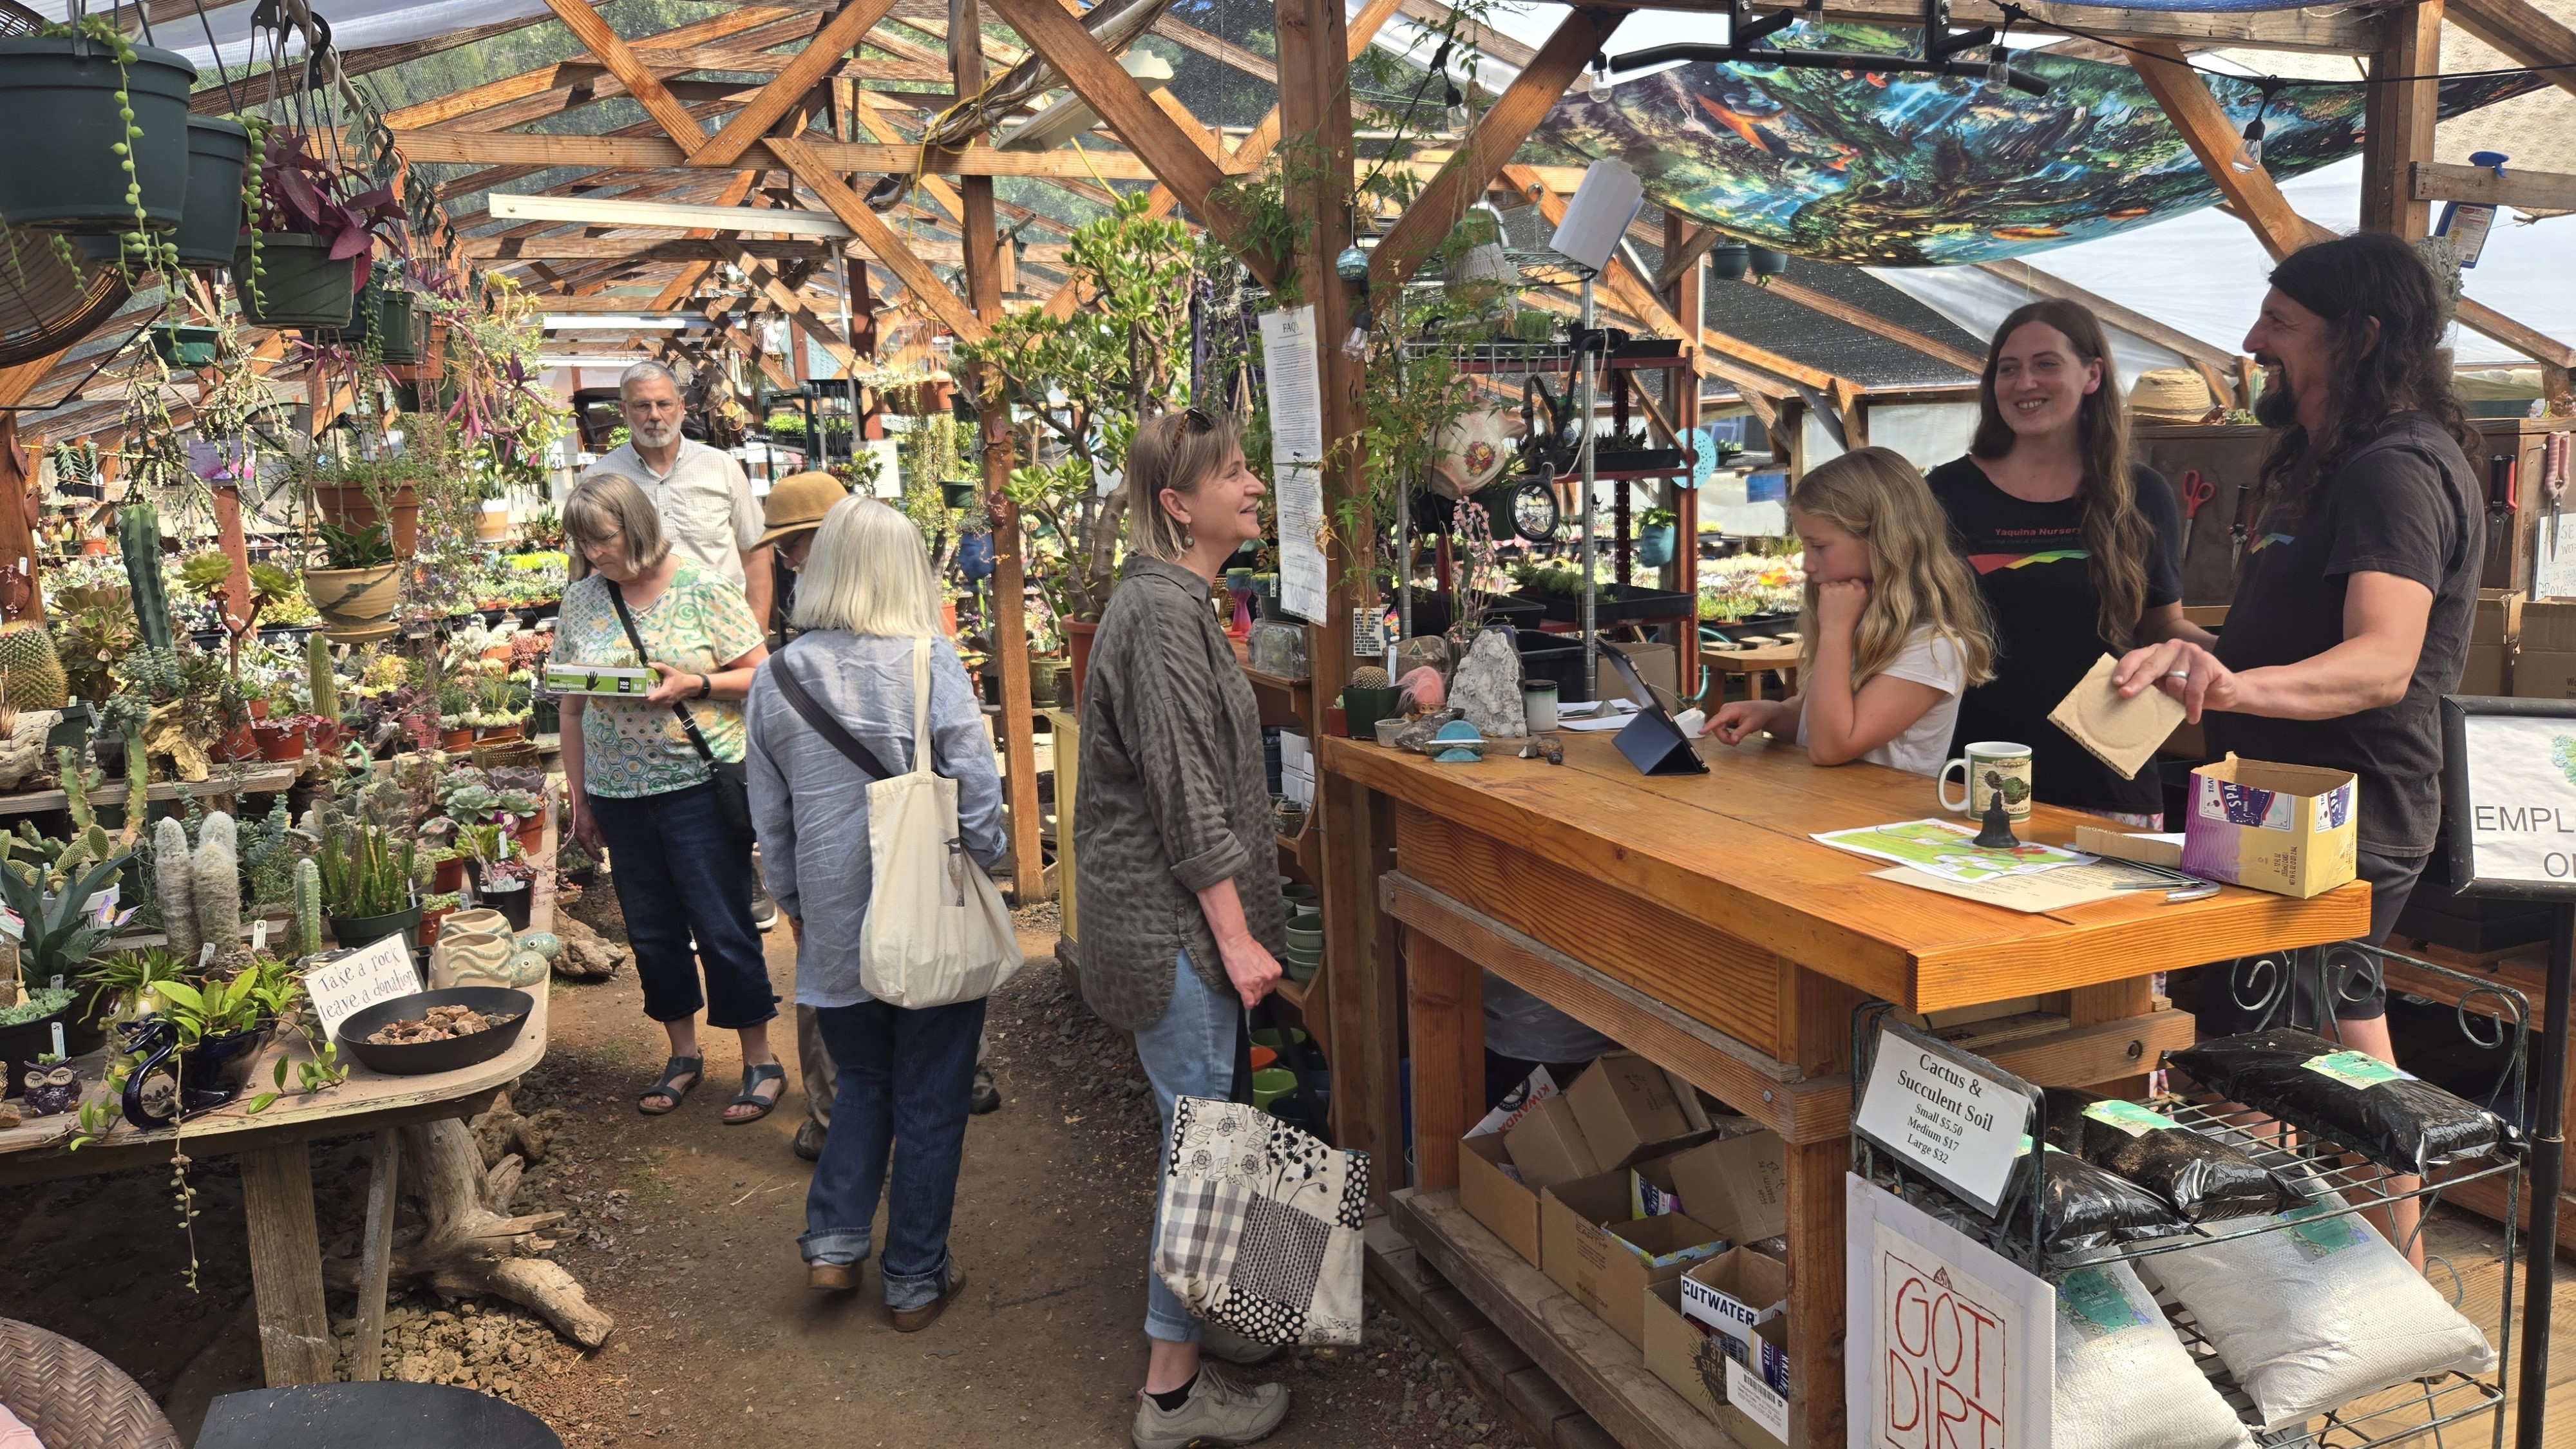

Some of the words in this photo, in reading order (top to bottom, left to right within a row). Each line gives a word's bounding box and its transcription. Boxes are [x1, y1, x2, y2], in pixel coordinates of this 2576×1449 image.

[2224, 784, 2242, 808] SPA
[2475, 806, 2575, 833] EMPL
[2544, 852, 2576, 878] O
[318, 966, 354, 992] Take
[358, 963, 366, 977] a
[371, 943, 401, 971] rock
[319, 993, 360, 1021] leave
[363, 989, 370, 1004] a
[374, 969, 417, 997] donation
[1919, 1054, 1965, 1089] Cactus
[1969, 1079, 1982, 1098] &
[1497, 1083, 1550, 1133] KIWANDA
[1897, 1070, 1962, 1117] Succulent
[1964, 1105, 1994, 1132] Soil
[1915, 1104, 1938, 1124] Small
[1939, 1116, 1964, 1137] $5.50
[1907, 1133, 1932, 1155] Large
[1932, 1148, 1949, 1164] $32
[1908, 1116, 1941, 1144] Medium
[1942, 1135, 1959, 1151] $17
[1682, 1279, 1756, 1327] CUTWATER
[1895, 1276, 1996, 1399] GOT
[1889, 1348, 2002, 1449] DIRT
